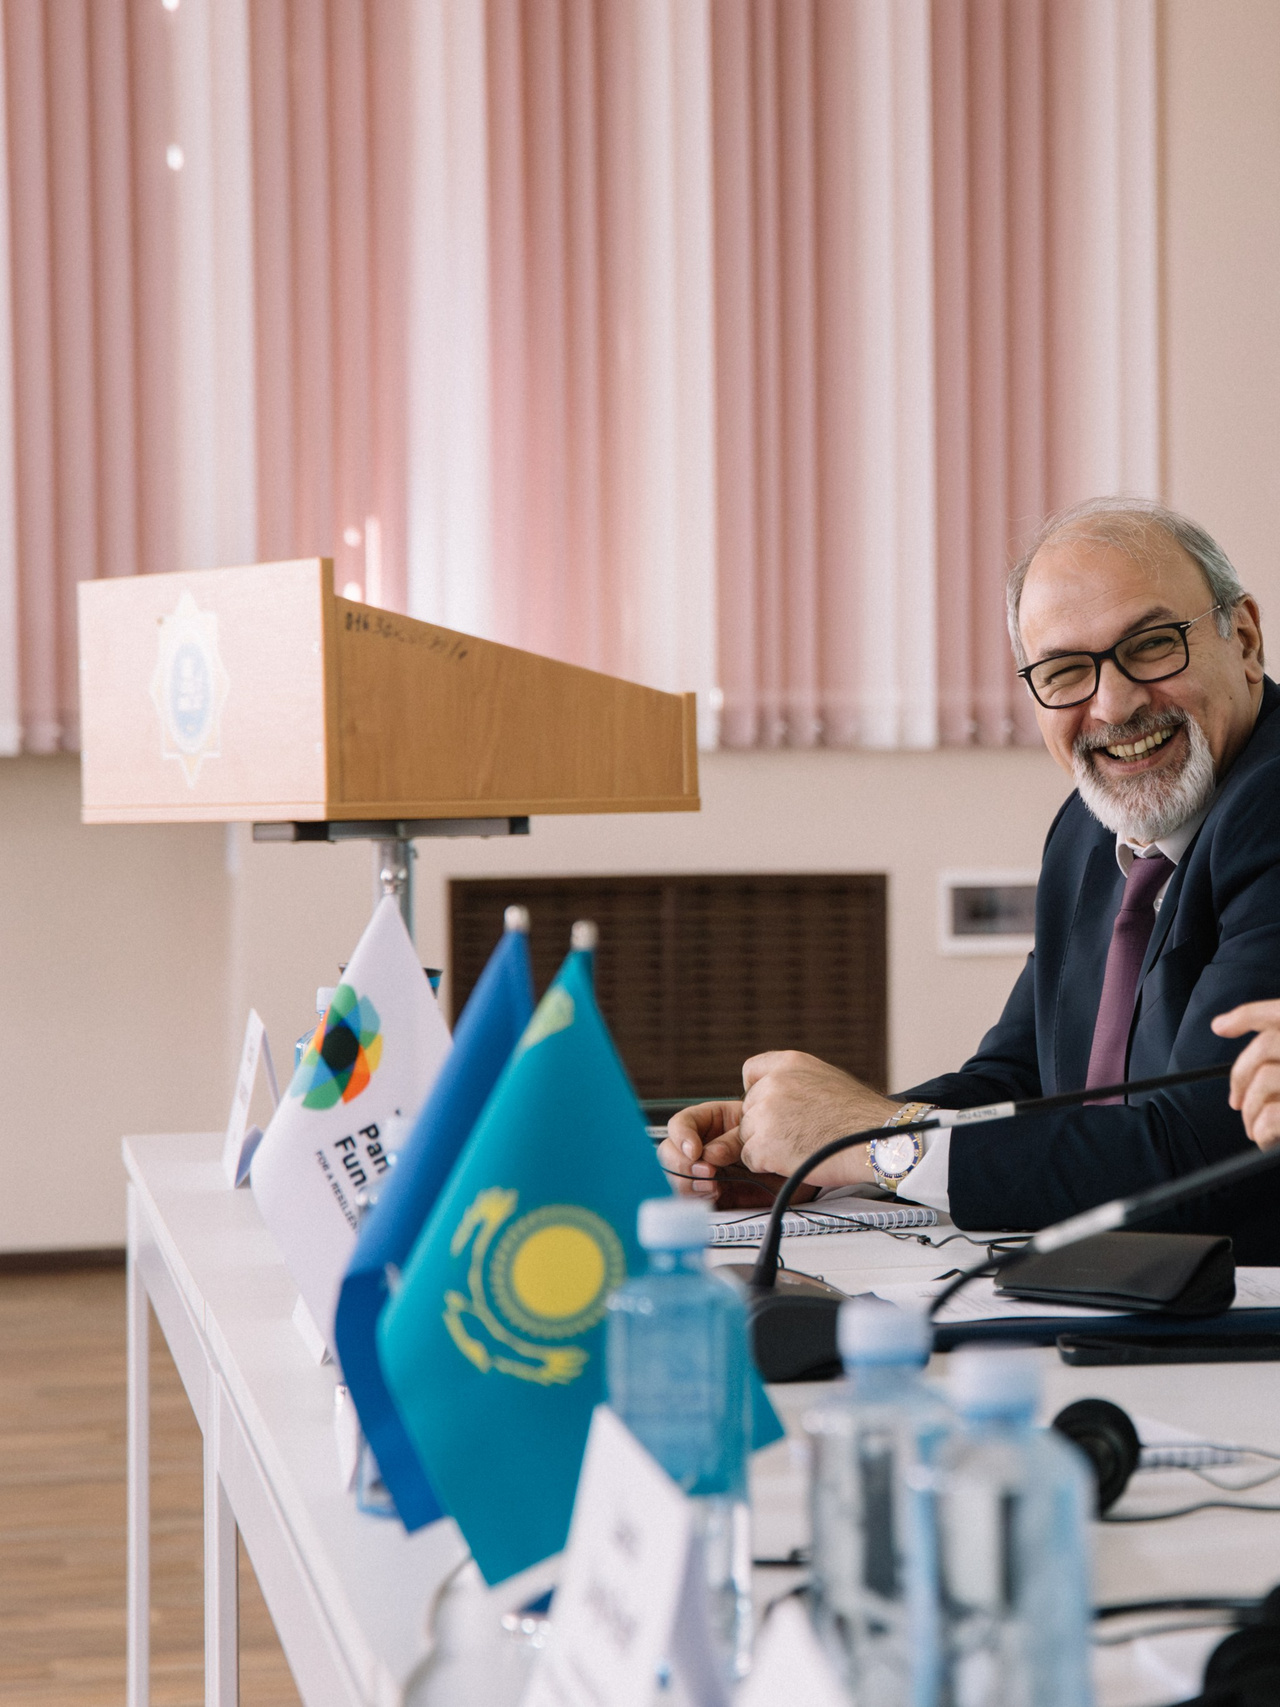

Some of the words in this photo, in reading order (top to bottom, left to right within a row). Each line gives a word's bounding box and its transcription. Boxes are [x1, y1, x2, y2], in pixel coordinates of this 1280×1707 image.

[316, 1151, 329, 1171] FOR
[331, 1182, 358, 1230] RESILIEN
[334, 1136, 367, 1191] Fun
